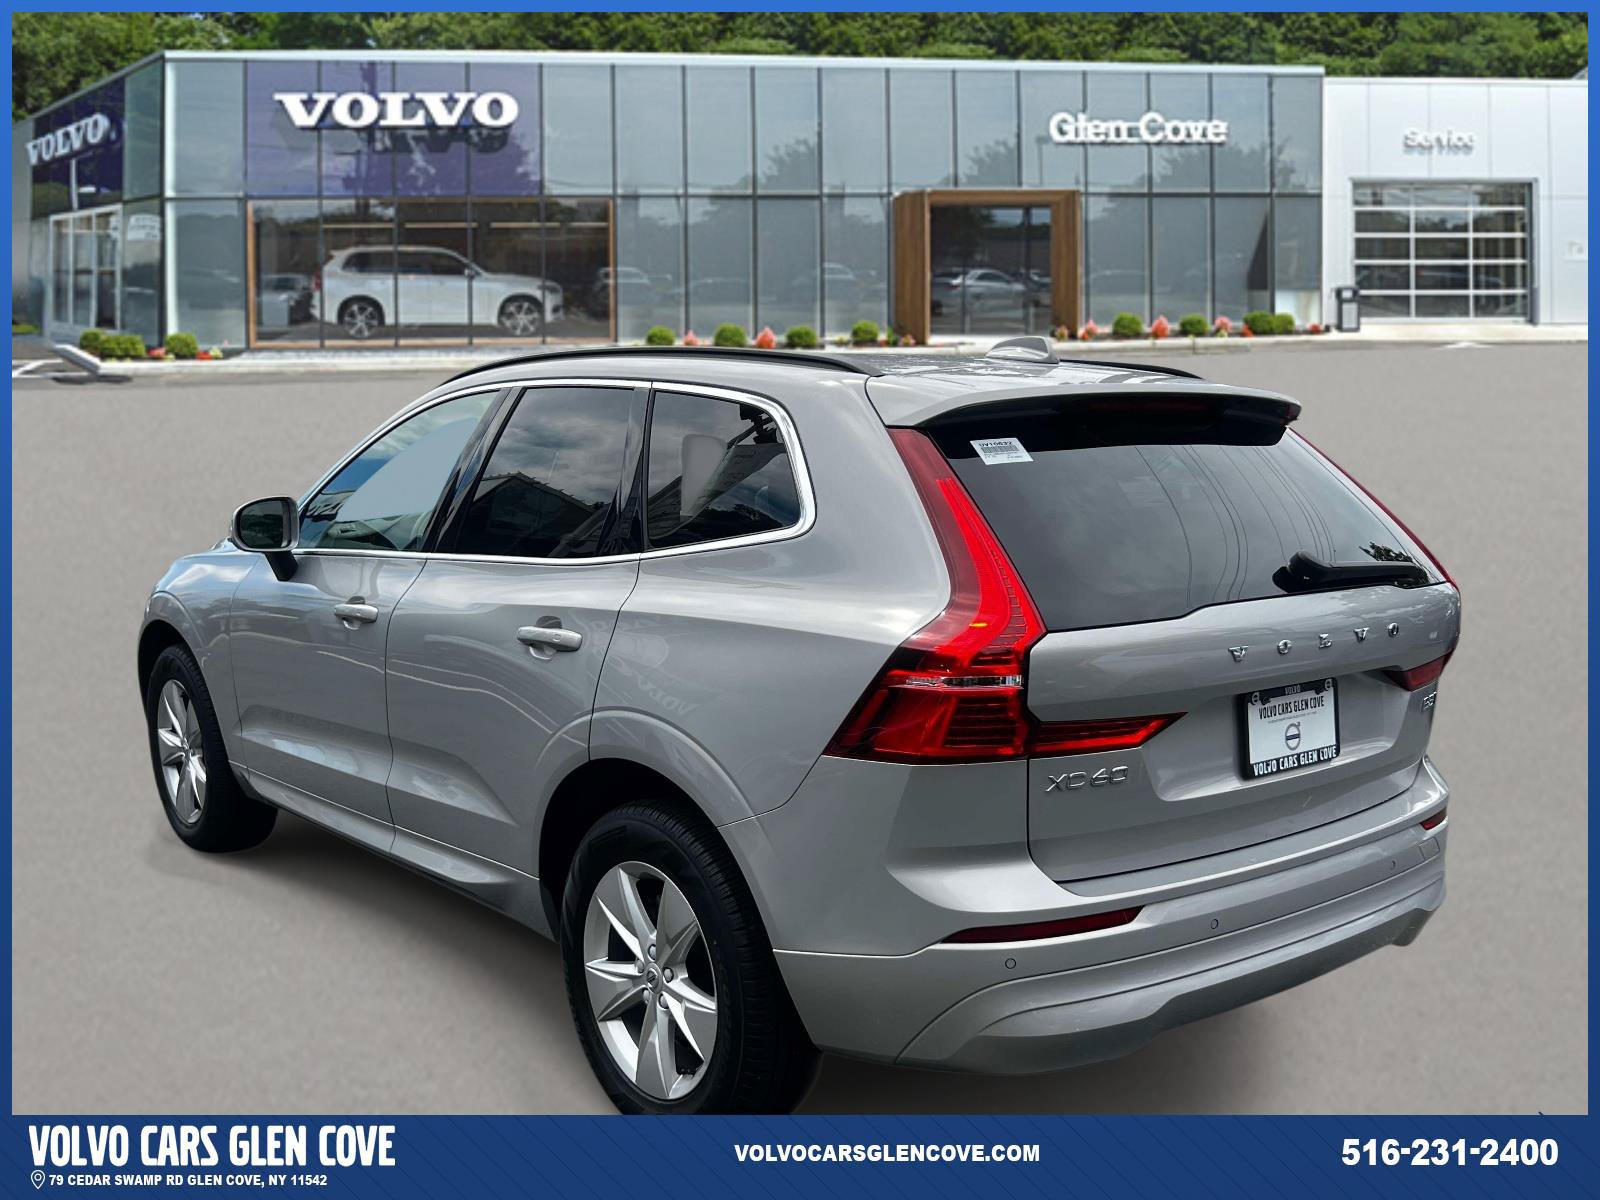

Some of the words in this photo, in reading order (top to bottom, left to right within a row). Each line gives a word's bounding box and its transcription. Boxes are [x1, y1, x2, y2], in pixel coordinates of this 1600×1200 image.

[273, 91, 520, 128] VOLVO
[25, 112, 111, 166] VOLVO
[1049, 112, 1129, 143] Glen
[1138, 111, 1229, 143] Cove
[1402, 128, 1476, 155] Service
[1228, 622, 1400, 662] VOLVO
[1259, 704, 1277, 720] VOLVO
[1278, 701, 1293, 716] CARS
[1294, 698, 1309, 712] GLEN
[1310, 695, 1325, 709] COVE
[1253, 760, 1277, 776] VOLVO
[1280, 755, 1298, 770] CARS
[1300, 750, 1318, 765] GLEN
[1320, 745, 1337, 760] COVE
[1045, 766, 1129, 792] XC60
